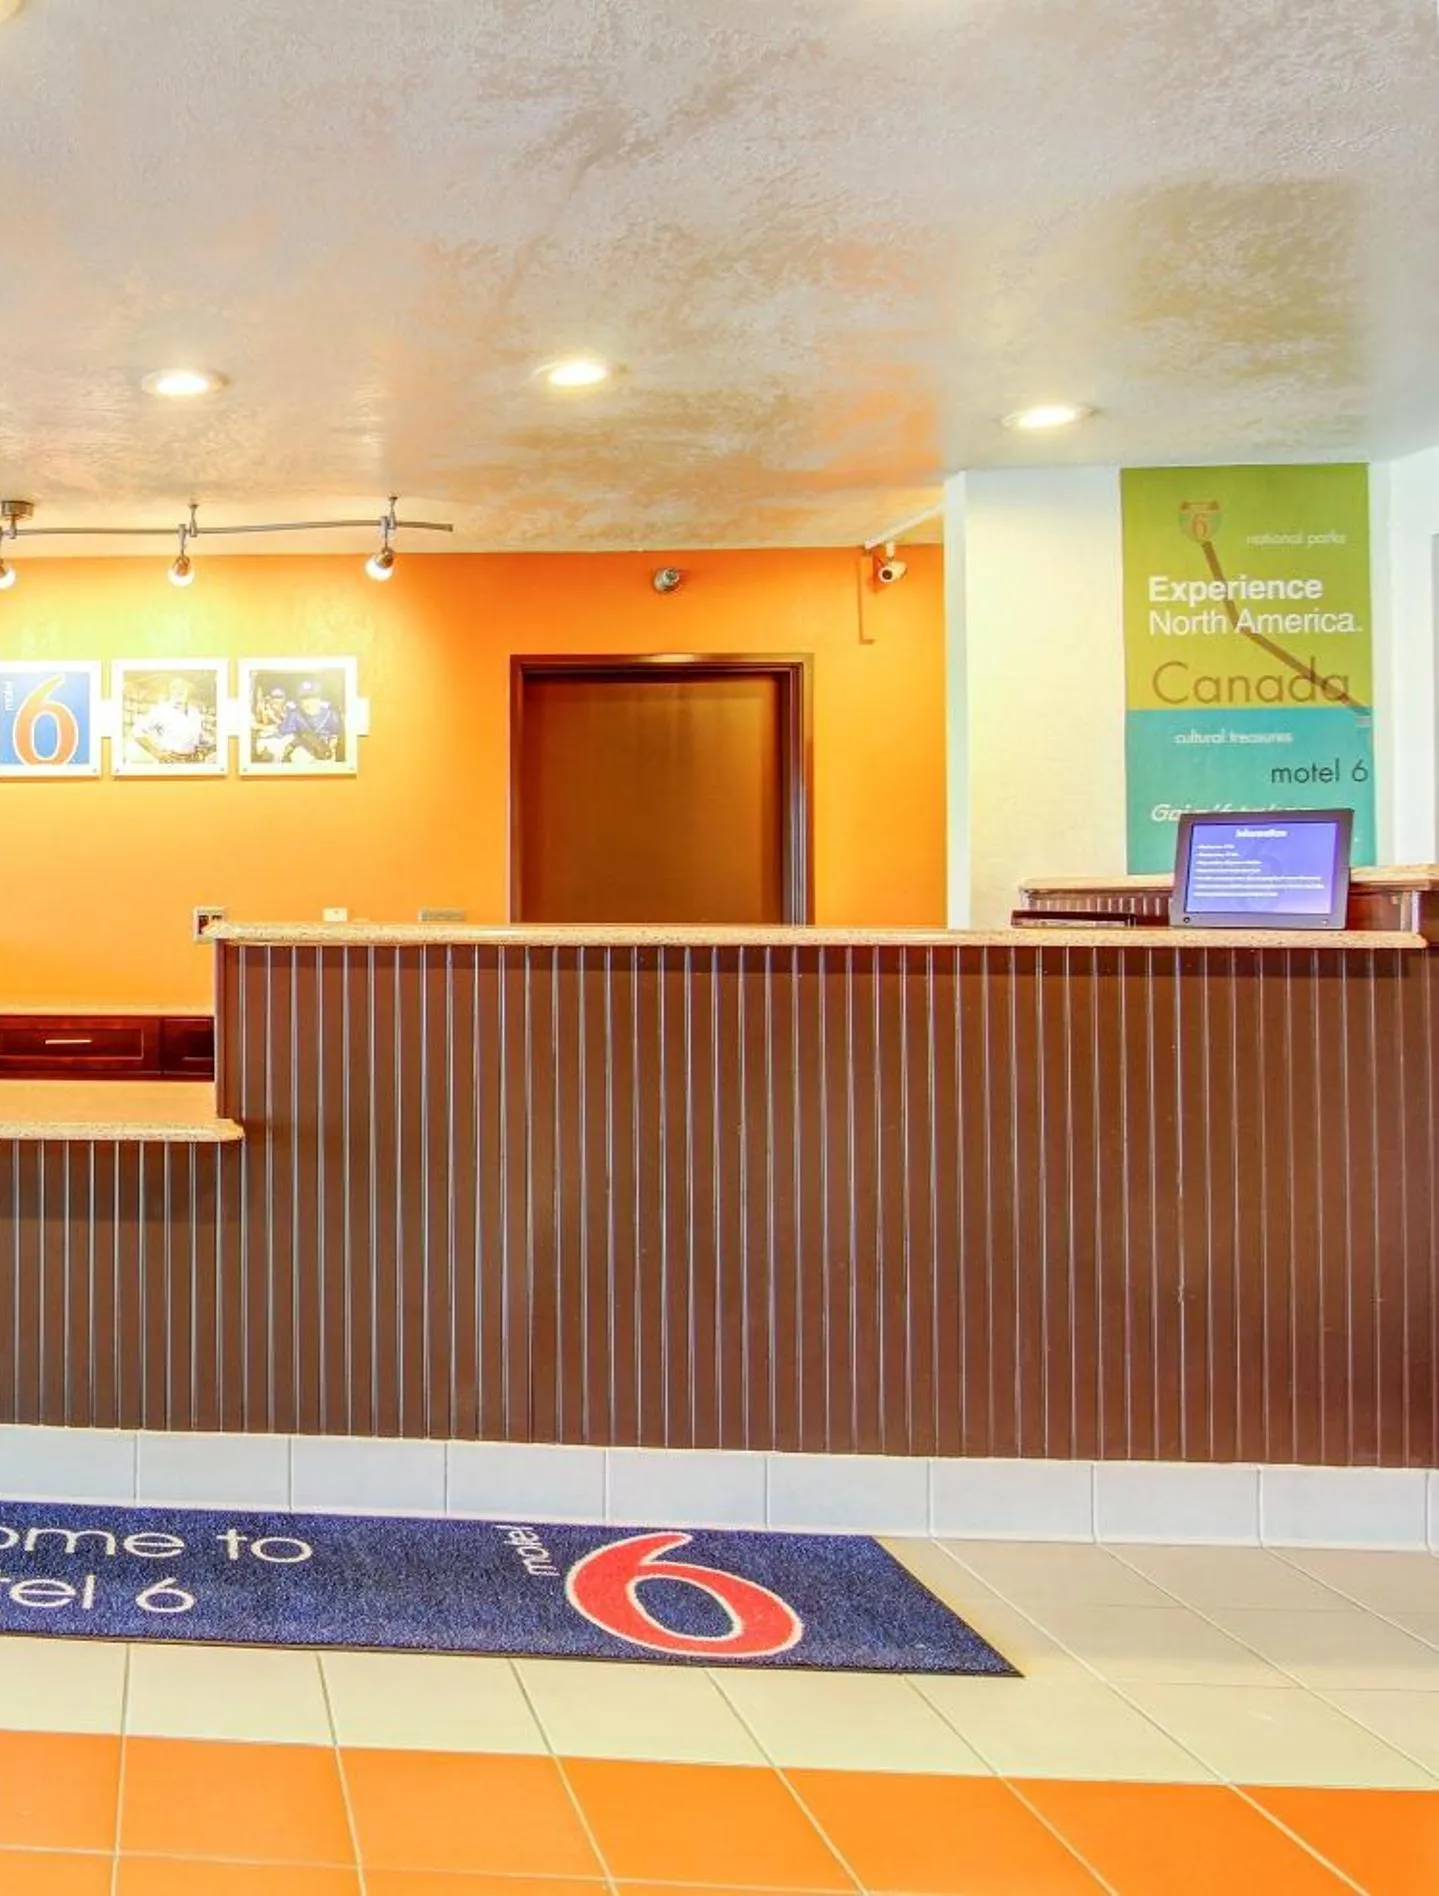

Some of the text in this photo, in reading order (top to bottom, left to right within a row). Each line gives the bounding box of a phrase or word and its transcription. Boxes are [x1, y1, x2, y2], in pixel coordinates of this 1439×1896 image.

[1148, 575, 1323, 607] Experience
[1148, 608, 1363, 637] North America.
[1152, 656, 1350, 705] Canada
[12, 672, 79, 766] 6
[1173, 729, 1294, 744] cultural treasures
[1270, 758, 1369, 784] motel 6
[216, 1528, 313, 1564] to
[495, 1524, 561, 1577] motel
[135, 1577, 197, 1614] 6
[565, 1531, 804, 1658] 6
